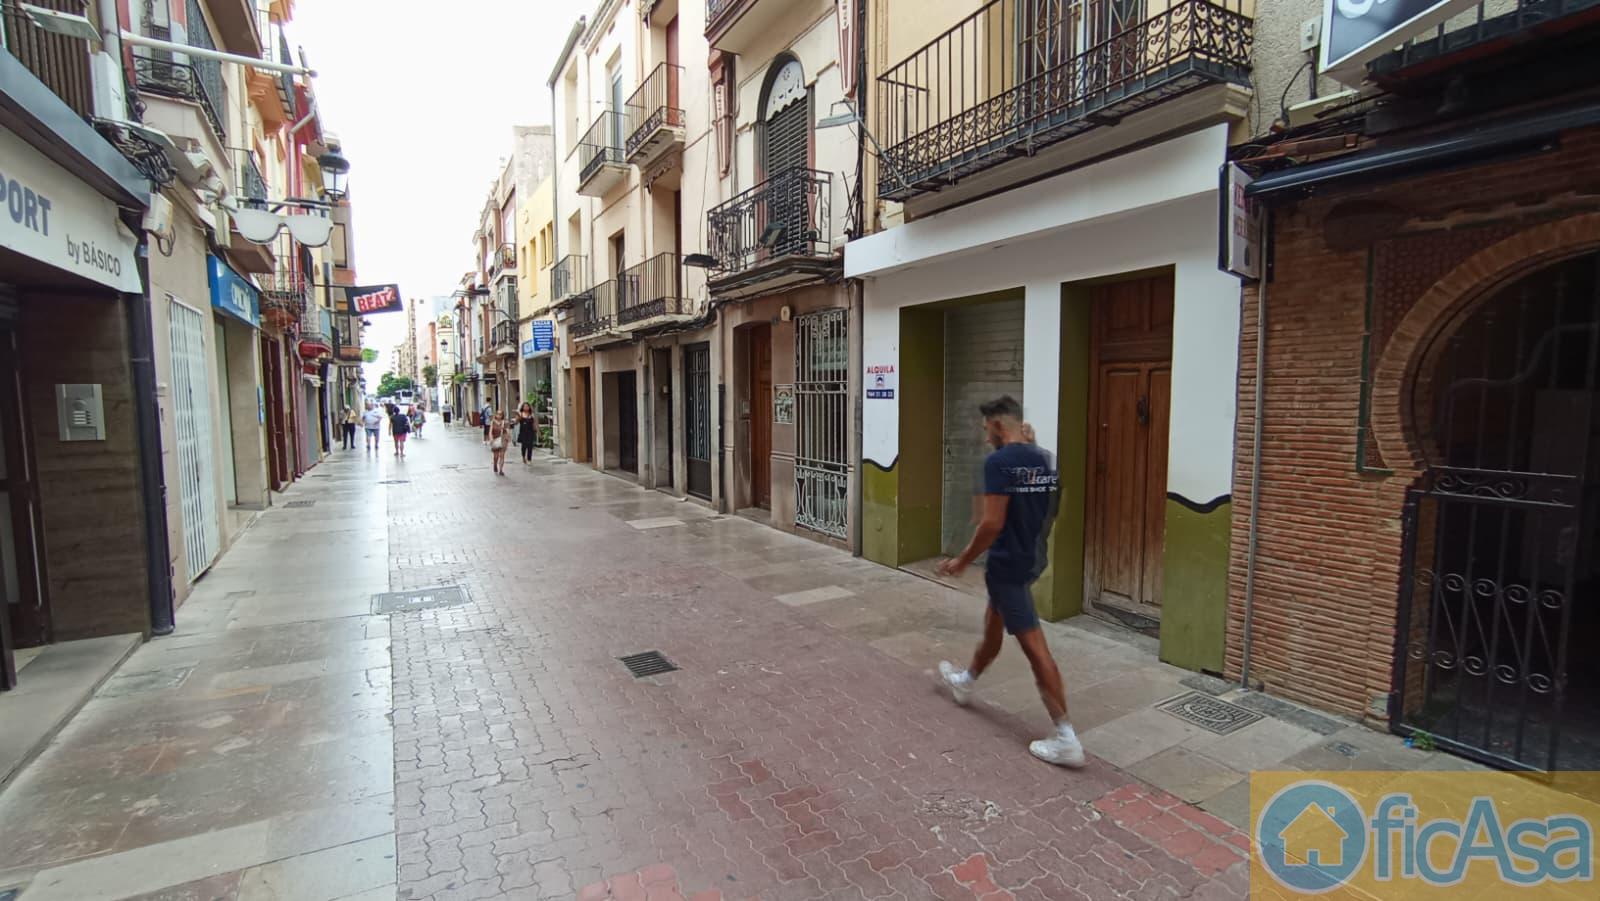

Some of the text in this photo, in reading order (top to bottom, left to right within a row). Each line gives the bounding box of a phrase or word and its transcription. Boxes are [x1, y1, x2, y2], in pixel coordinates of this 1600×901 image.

[66, 234, 121, 276] by BÁSICO
[866, 365, 894, 374] ALQUILA
